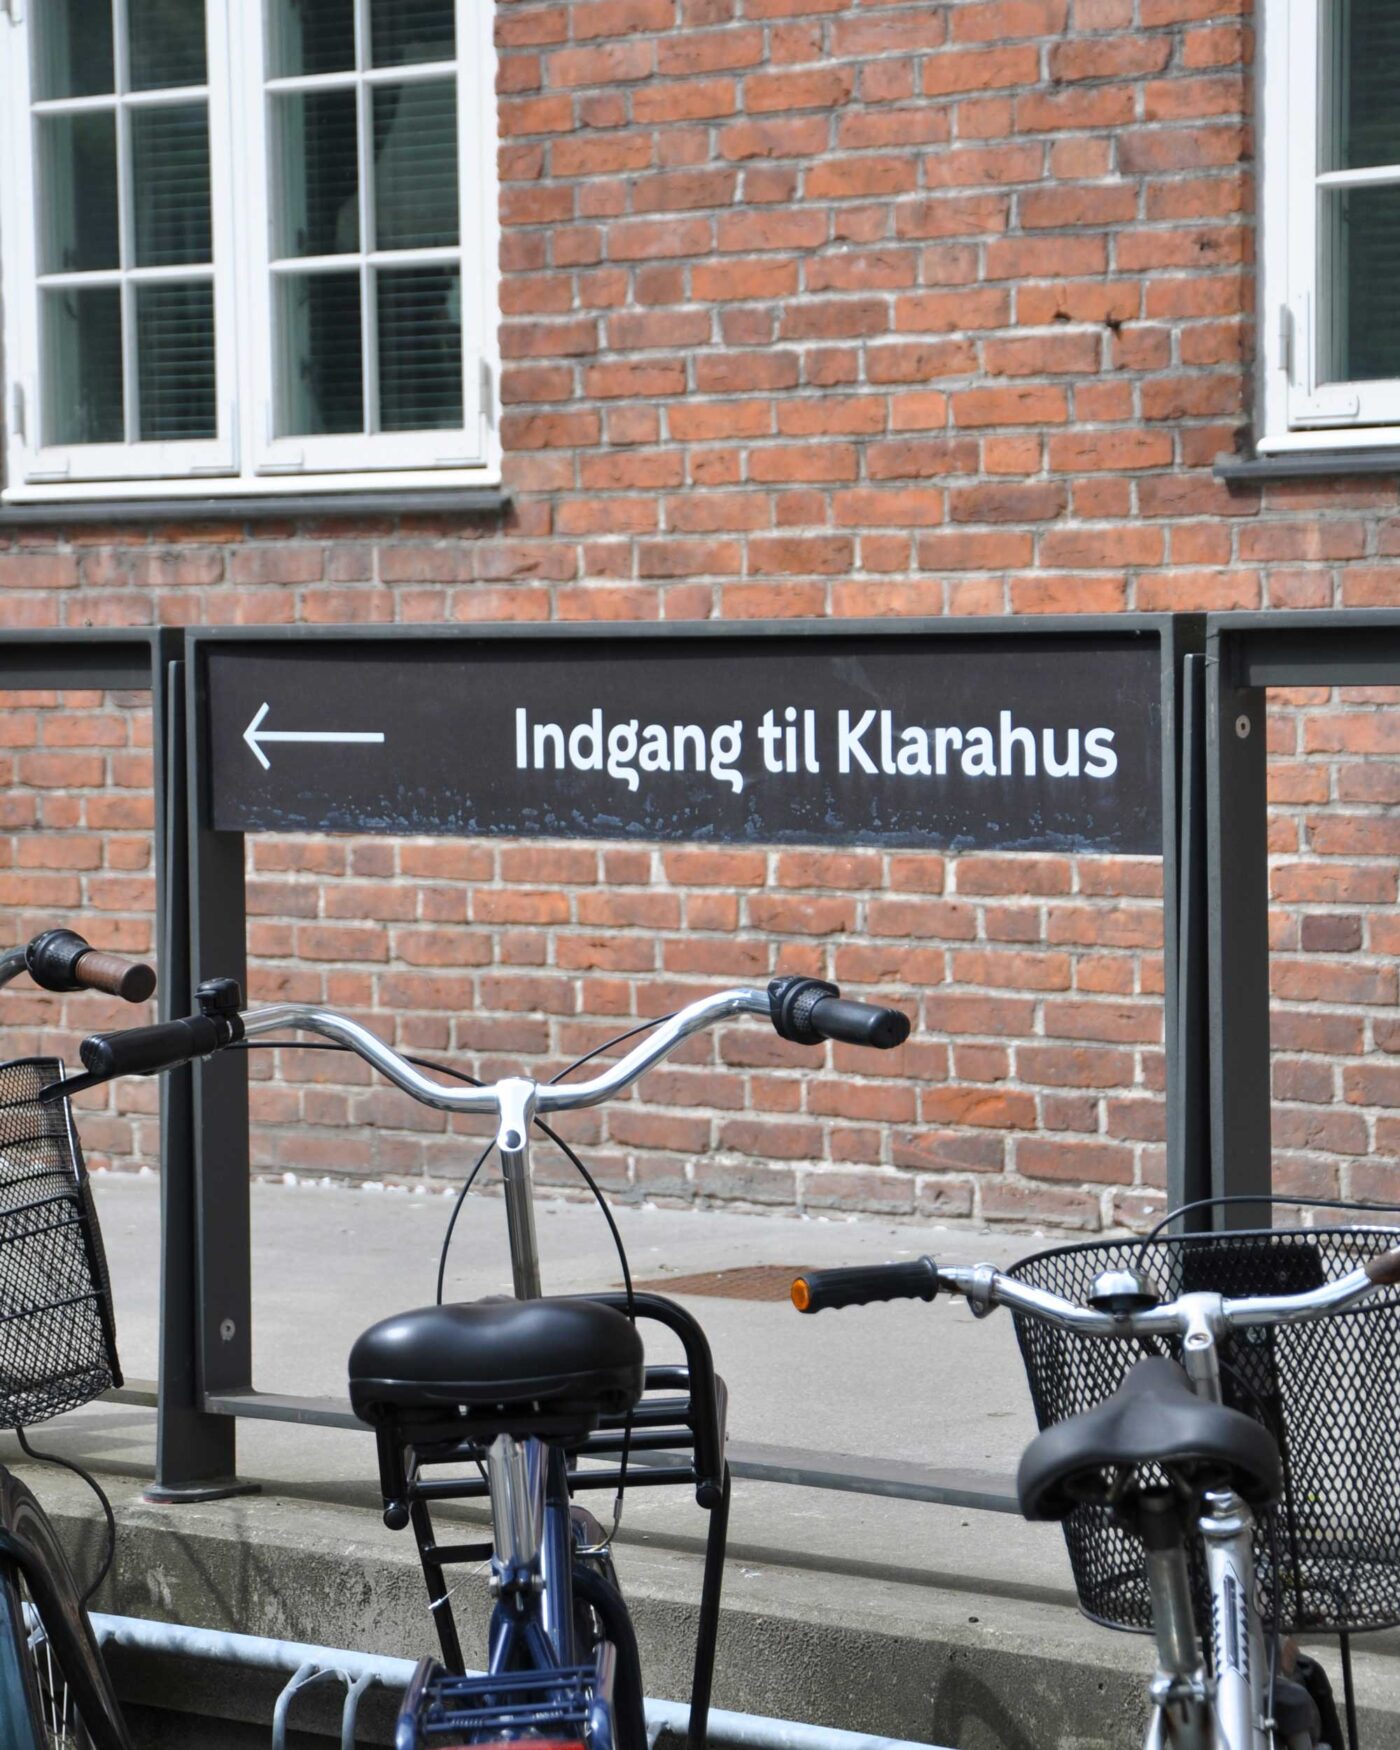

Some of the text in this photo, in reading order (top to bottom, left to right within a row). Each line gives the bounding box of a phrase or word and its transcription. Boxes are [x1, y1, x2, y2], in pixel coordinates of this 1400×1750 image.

[515, 706, 1118, 794] Indgang til Klarahus
